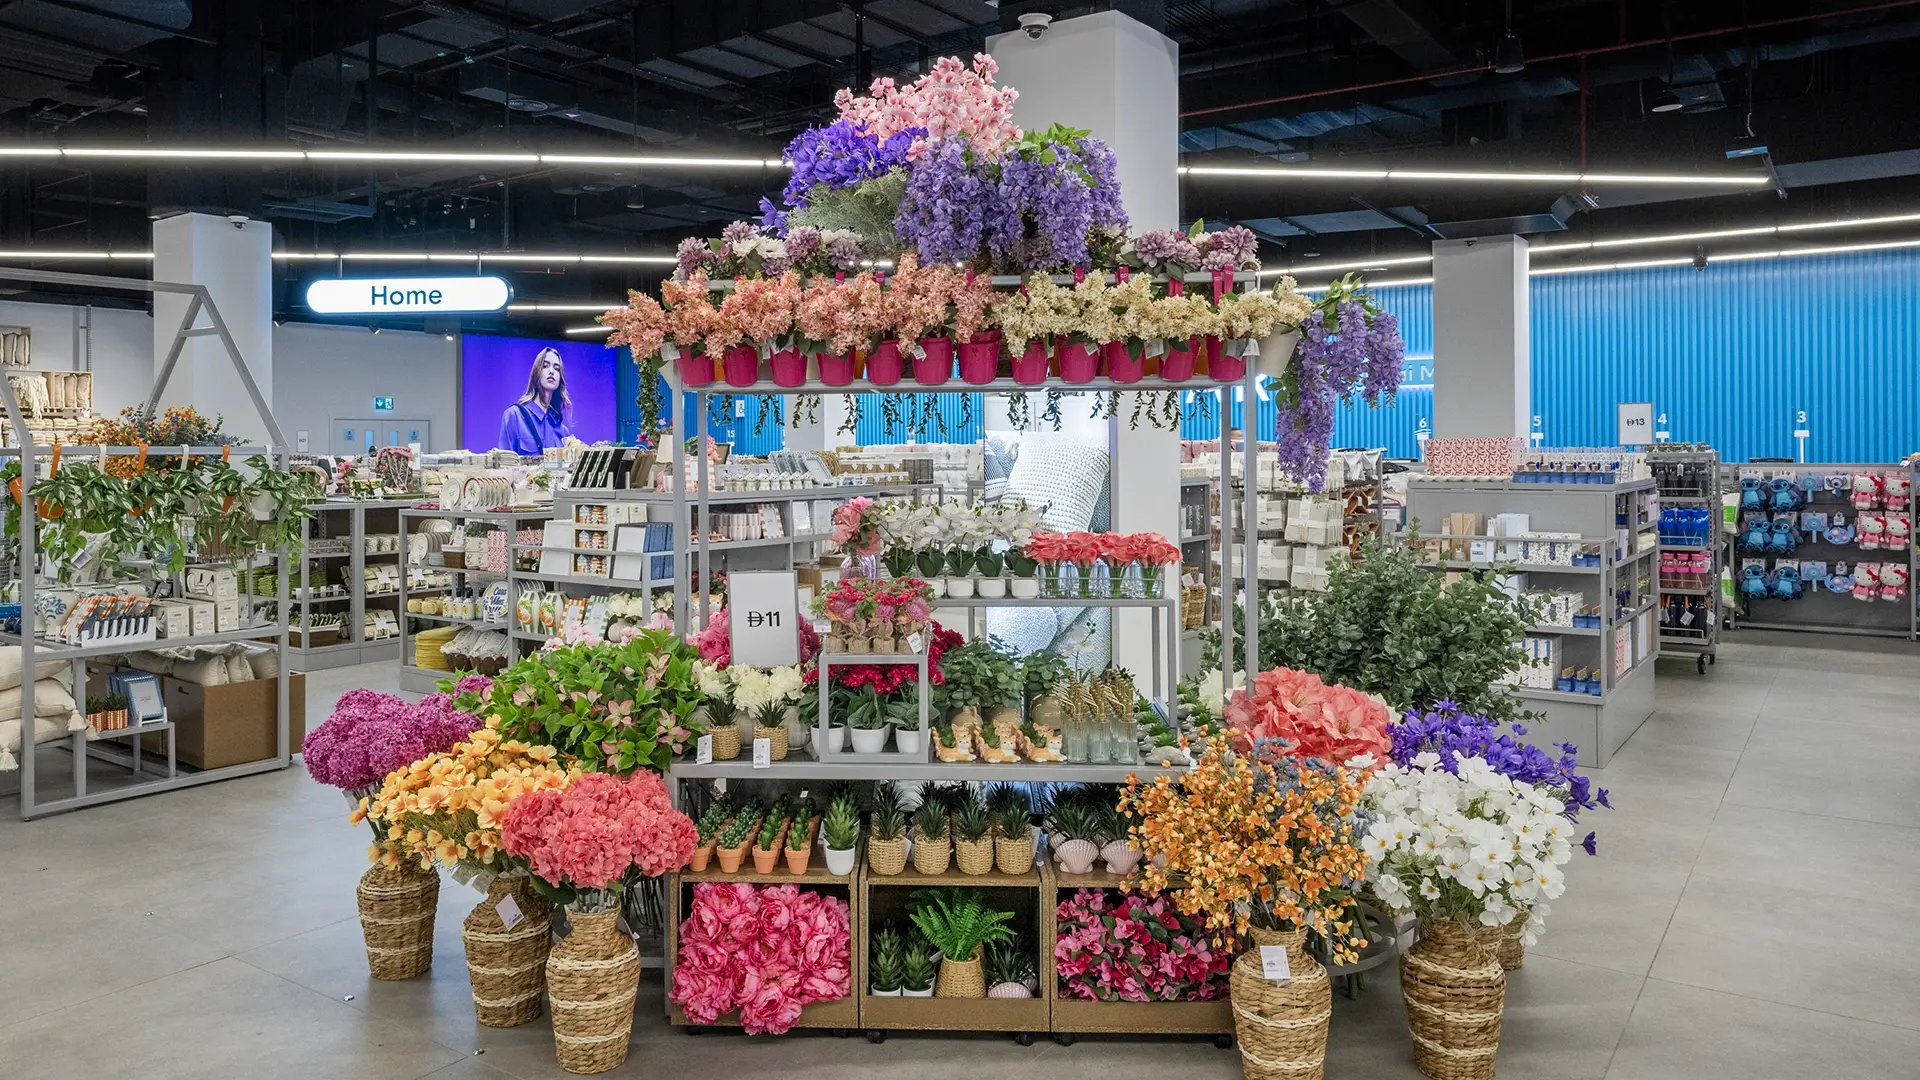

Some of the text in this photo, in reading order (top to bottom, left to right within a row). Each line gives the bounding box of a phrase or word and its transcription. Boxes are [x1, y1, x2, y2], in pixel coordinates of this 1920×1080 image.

[371, 285, 442, 305] Home
[1533, 415, 1541, 427] 5
[1658, 414, 1667, 425] 4
[1796, 411, 1807, 423] 3
[1419, 418, 1427, 428] 6
[727, 430, 735, 438] 15
